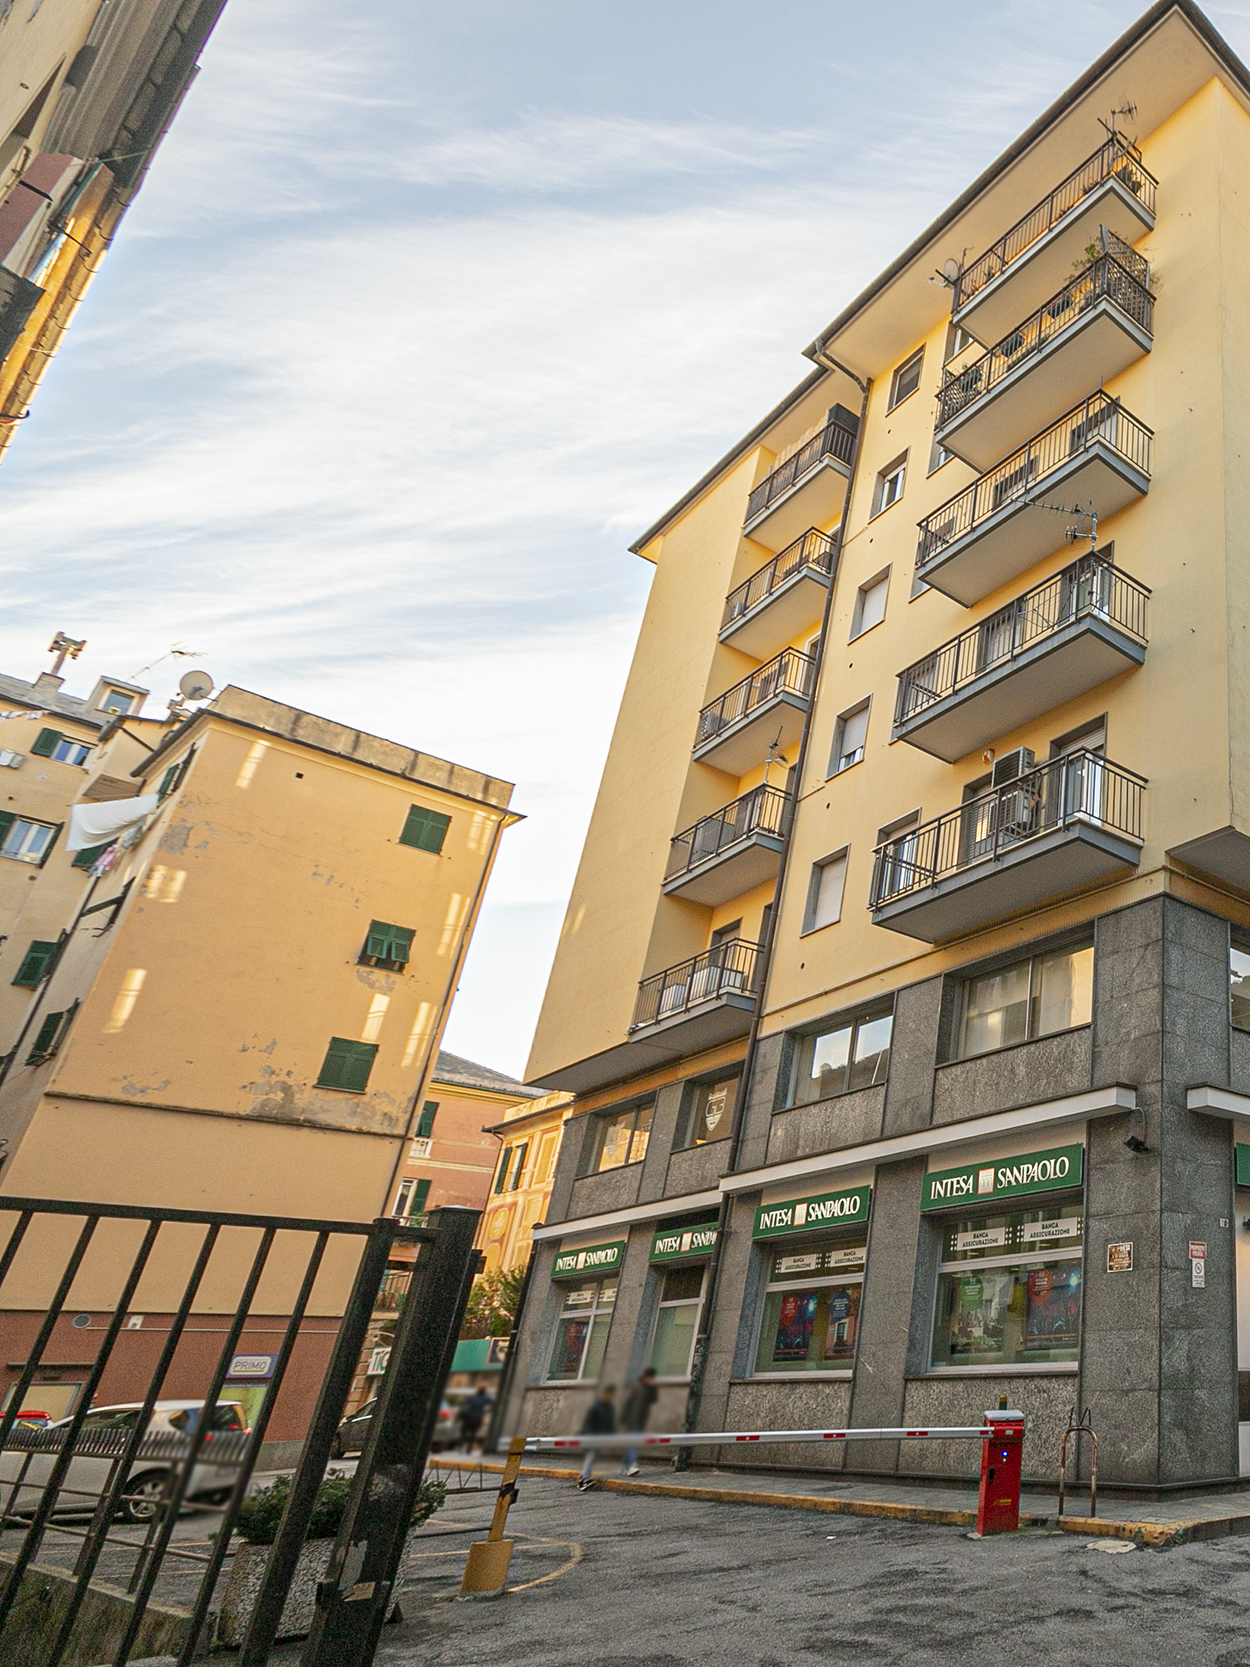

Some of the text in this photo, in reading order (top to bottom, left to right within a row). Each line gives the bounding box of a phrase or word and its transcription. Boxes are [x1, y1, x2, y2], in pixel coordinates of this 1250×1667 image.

[930, 1156, 1069, 1200] INTESA SANPAOLO
[760, 1195, 860, 1229] INTESA SANPAOLO
[1041, 1222, 1059, 1230] BANCA
[973, 1231, 988, 1239] BANCA
[1029, 1228, 1071, 1239] ASSICURAZIONE
[655, 1237, 681, 1254] INTESA
[962, 1237, 999, 1247] ASSICURAZIONE
[555, 1256, 577, 1271] INTESA
[233, 1361, 268, 1370] PRIMO
